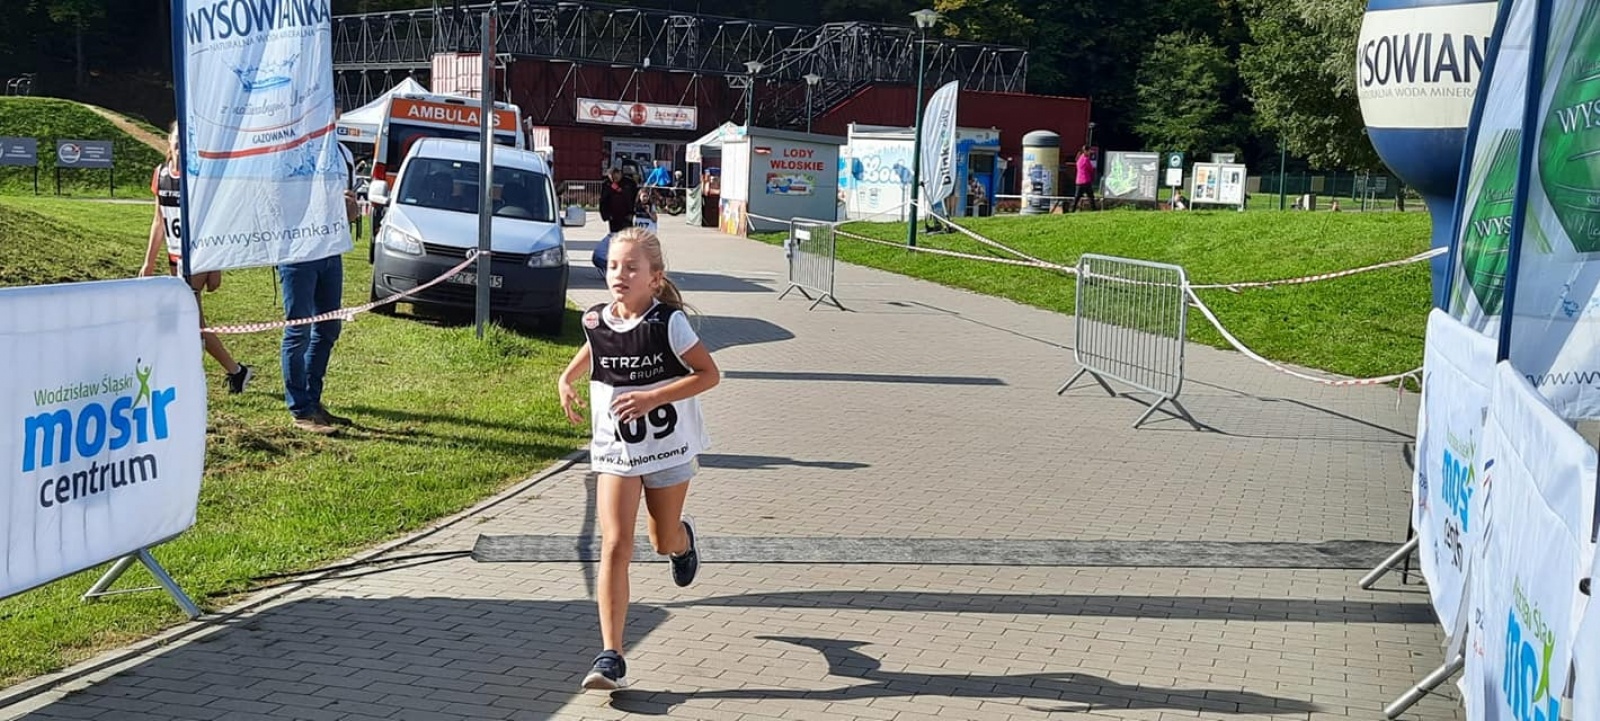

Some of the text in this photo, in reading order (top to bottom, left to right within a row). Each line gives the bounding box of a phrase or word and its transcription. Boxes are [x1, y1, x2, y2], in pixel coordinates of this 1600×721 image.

[186, 0, 331, 45] WYSOWIANKA
[1395, 87, 1425, 97] WODA
[408, 104, 501, 127] AMBULAS
[252, 128, 296, 145] GAZOWANA
[783, 148, 815, 158] LODY
[770, 160, 825, 171] WŁOSKIE
[191, 216, 347, 251] www.wysowianka.pl
[599, 353, 664, 370] ETRZAK
[629, 366, 665, 382] GRUPA
[34, 372, 134, 406] Wodzisław Śląski
[22, 387, 176, 472] mosir
[614, 402, 678, 444] 09
[40, 452, 158, 508] centrum
